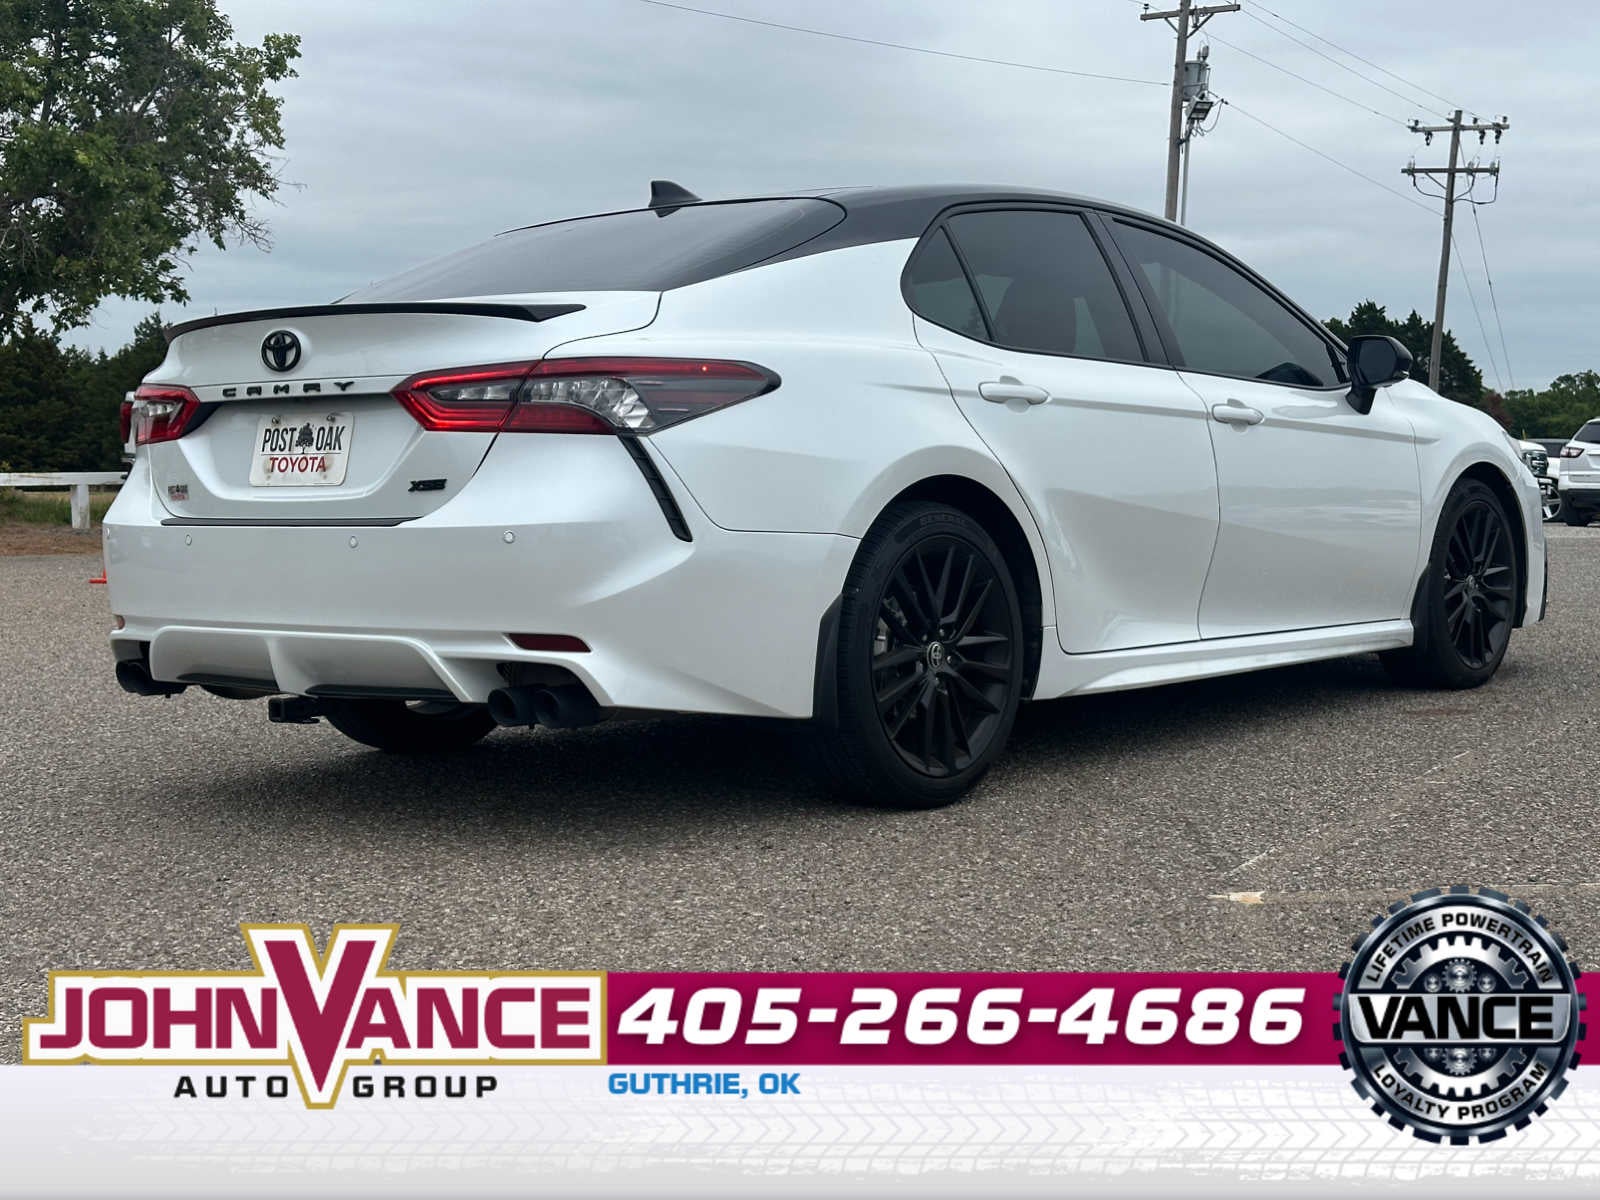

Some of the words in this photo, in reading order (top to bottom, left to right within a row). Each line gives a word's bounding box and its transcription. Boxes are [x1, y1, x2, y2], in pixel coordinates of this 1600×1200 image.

[222, 381, 355, 398] CAMRY
[261, 427, 297, 452] POST
[315, 426, 346, 451] OAK
[269, 456, 327, 473] TOYOTA
